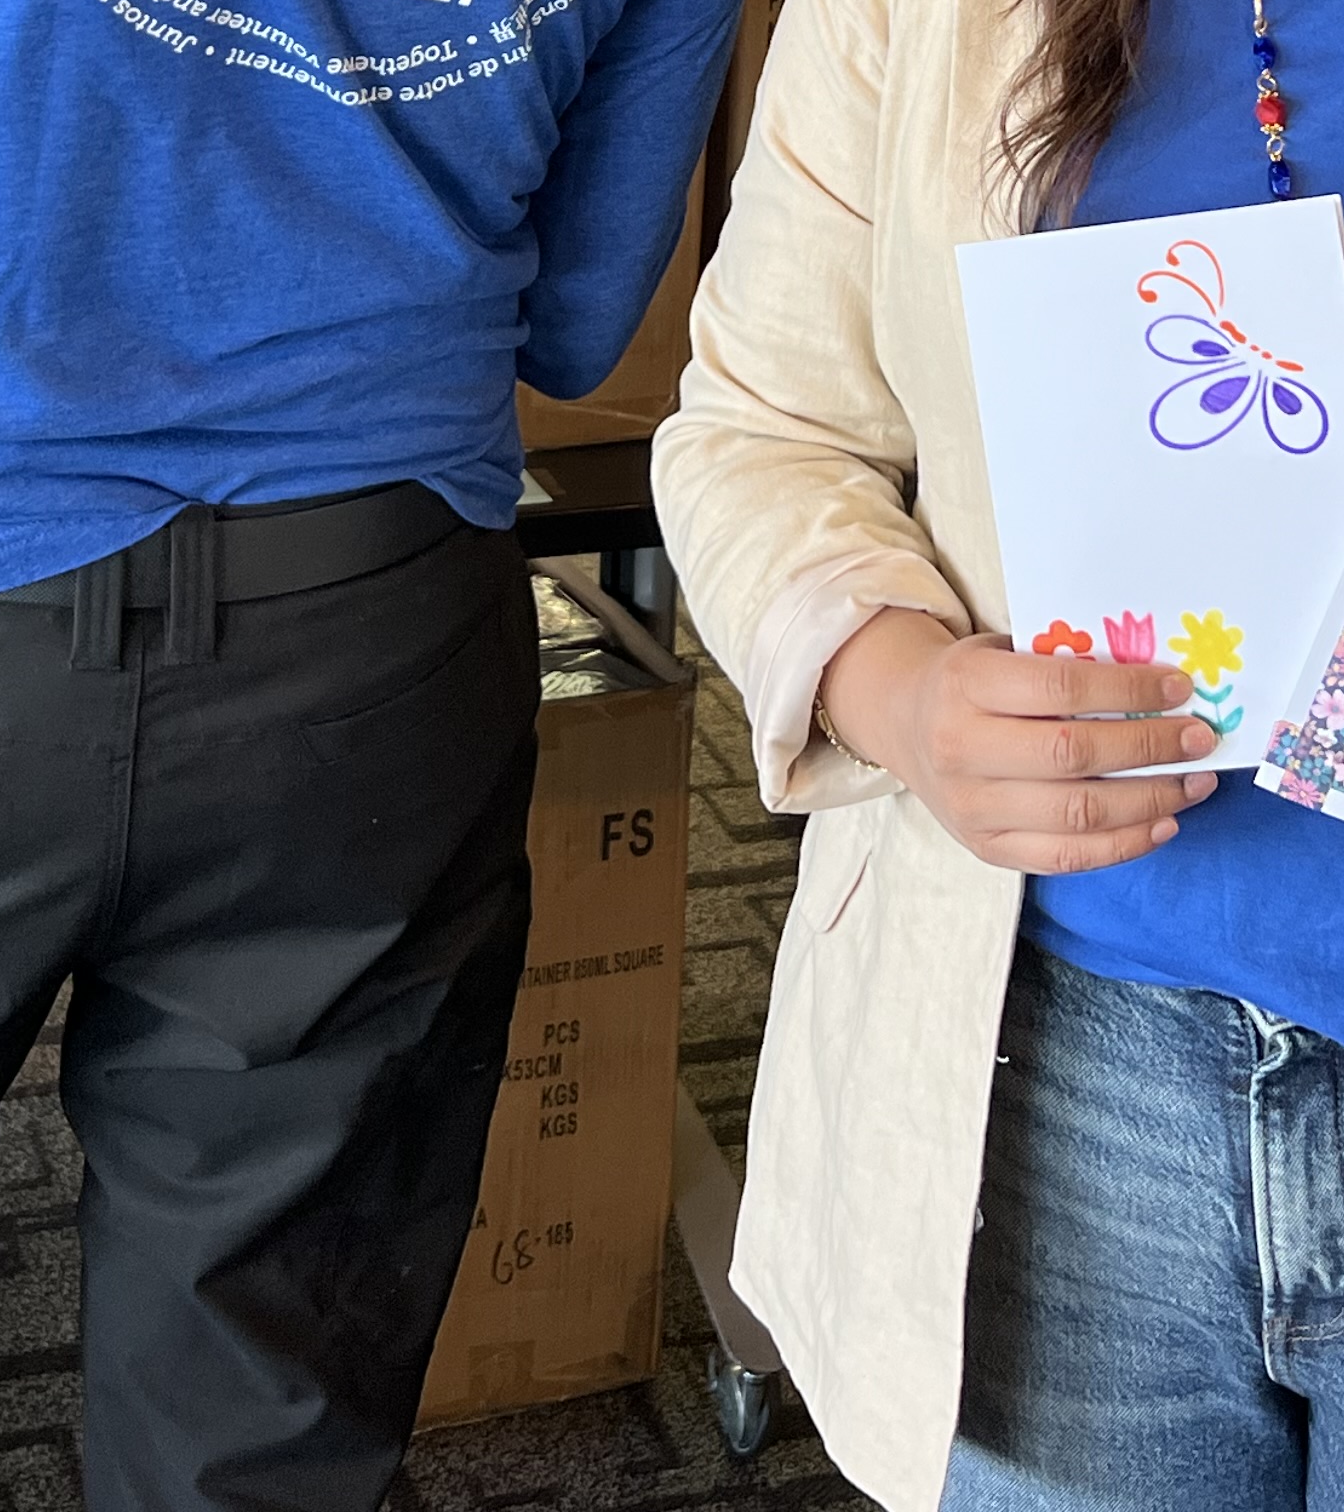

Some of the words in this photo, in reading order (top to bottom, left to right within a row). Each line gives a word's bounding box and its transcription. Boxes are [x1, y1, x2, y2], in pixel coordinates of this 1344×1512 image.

[113, 0, 198, 53] Juntos
[205, 7, 320, 70] volunteer
[468, 59, 499, 78] de
[399, 69, 464, 103] notre
[600, 808, 655, 862] FS
[614, 944, 664, 973] SQUARE
[543, 1019, 581, 1047] PCS
[540, 1081, 580, 1109] KGS
[539, 1112, 578, 1140] KGS
